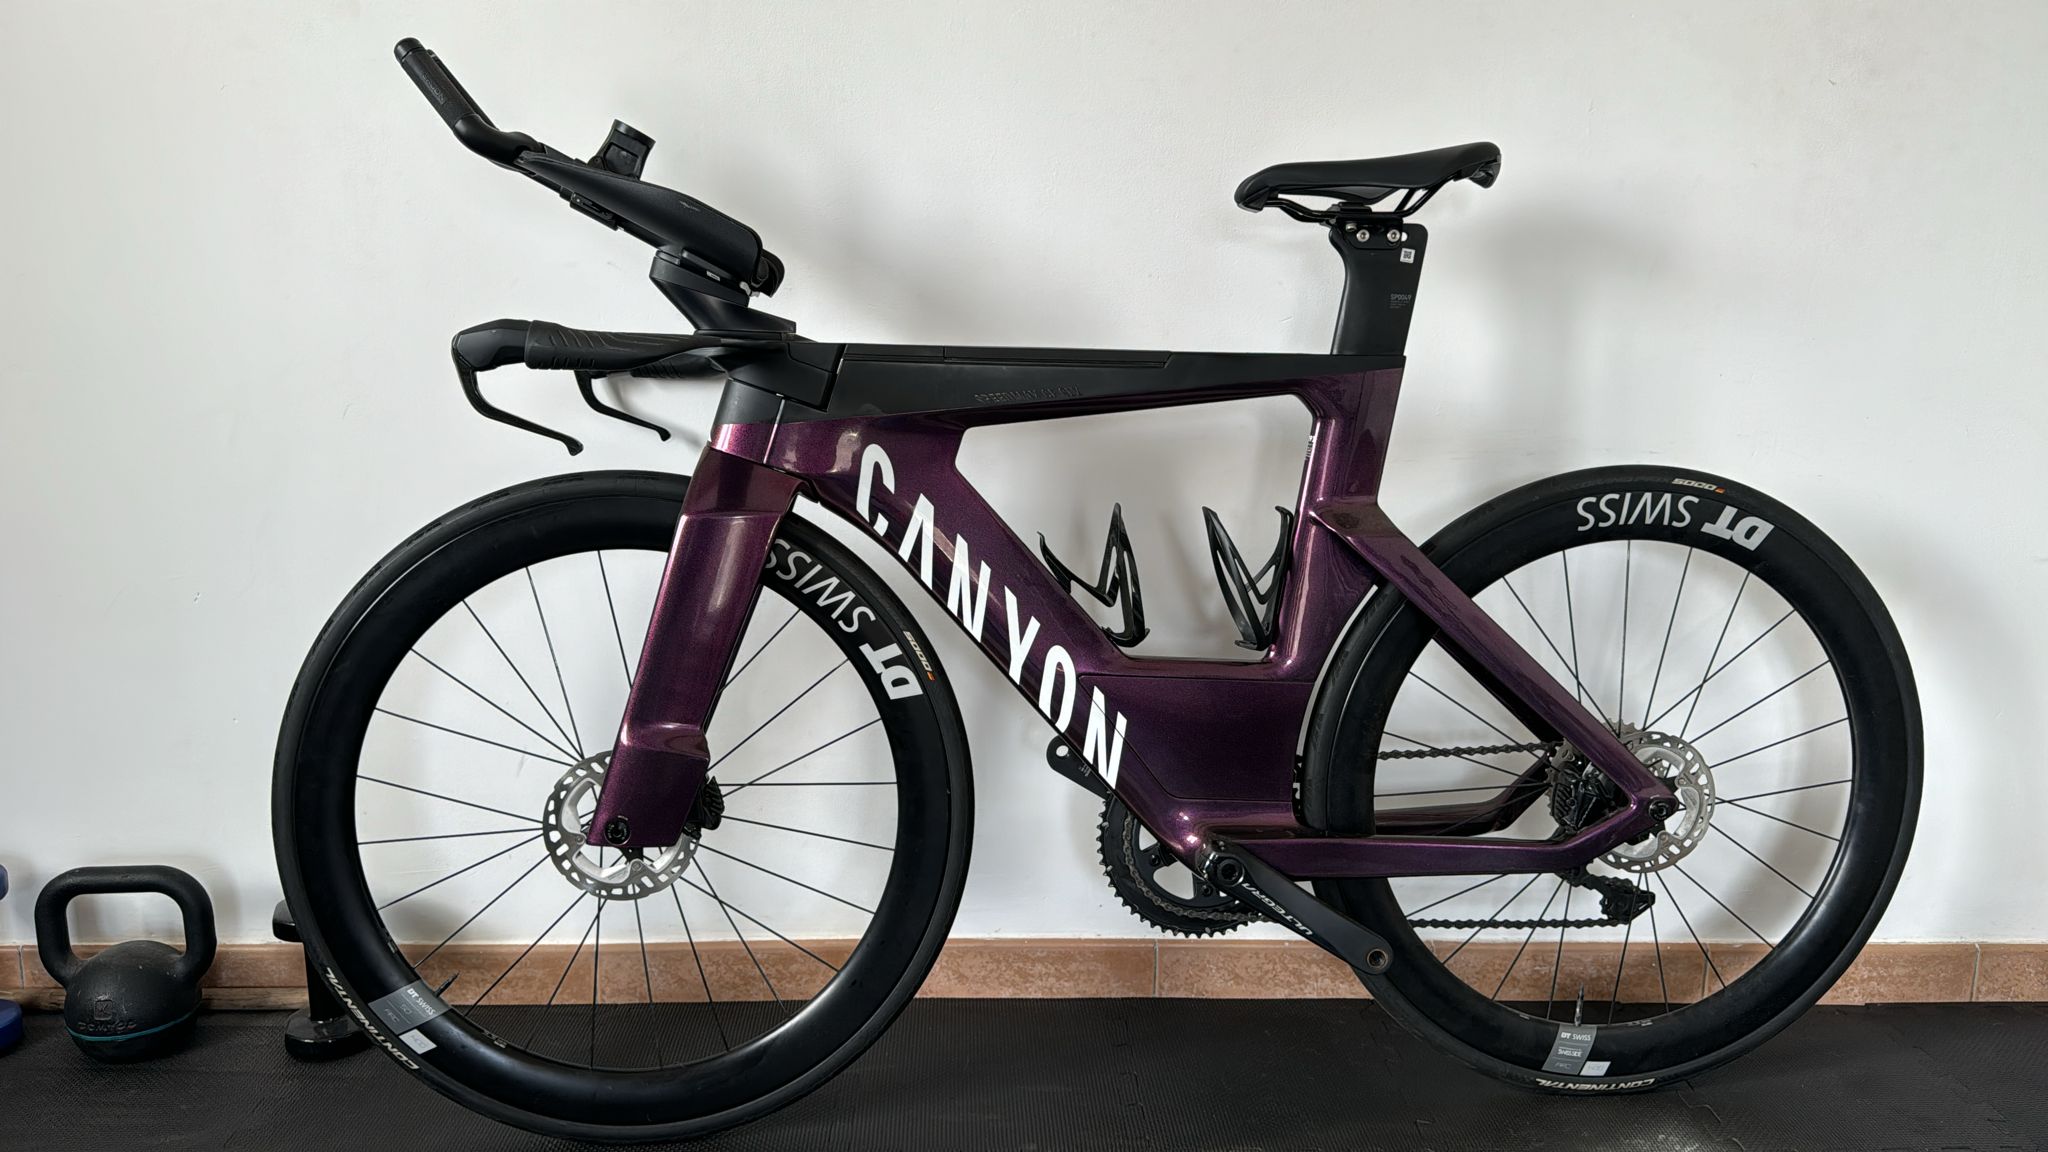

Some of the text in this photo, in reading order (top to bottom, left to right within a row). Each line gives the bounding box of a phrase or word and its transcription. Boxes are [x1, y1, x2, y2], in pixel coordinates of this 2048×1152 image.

[1576, 492, 1775, 551] DT SWISS
[855, 443, 1128, 790] CANYON
[858, 642, 924, 700] DT
[1241, 883, 1313, 936] ULTEGRA
[326, 967, 420, 1070] CONTINENTAL
[407, 988, 419, 998] DT
[416, 997, 436, 1016] SWISS
[1572, 1033, 1591, 1042] SWISS
[1535, 1078, 1656, 1091] CONTINENTAL
